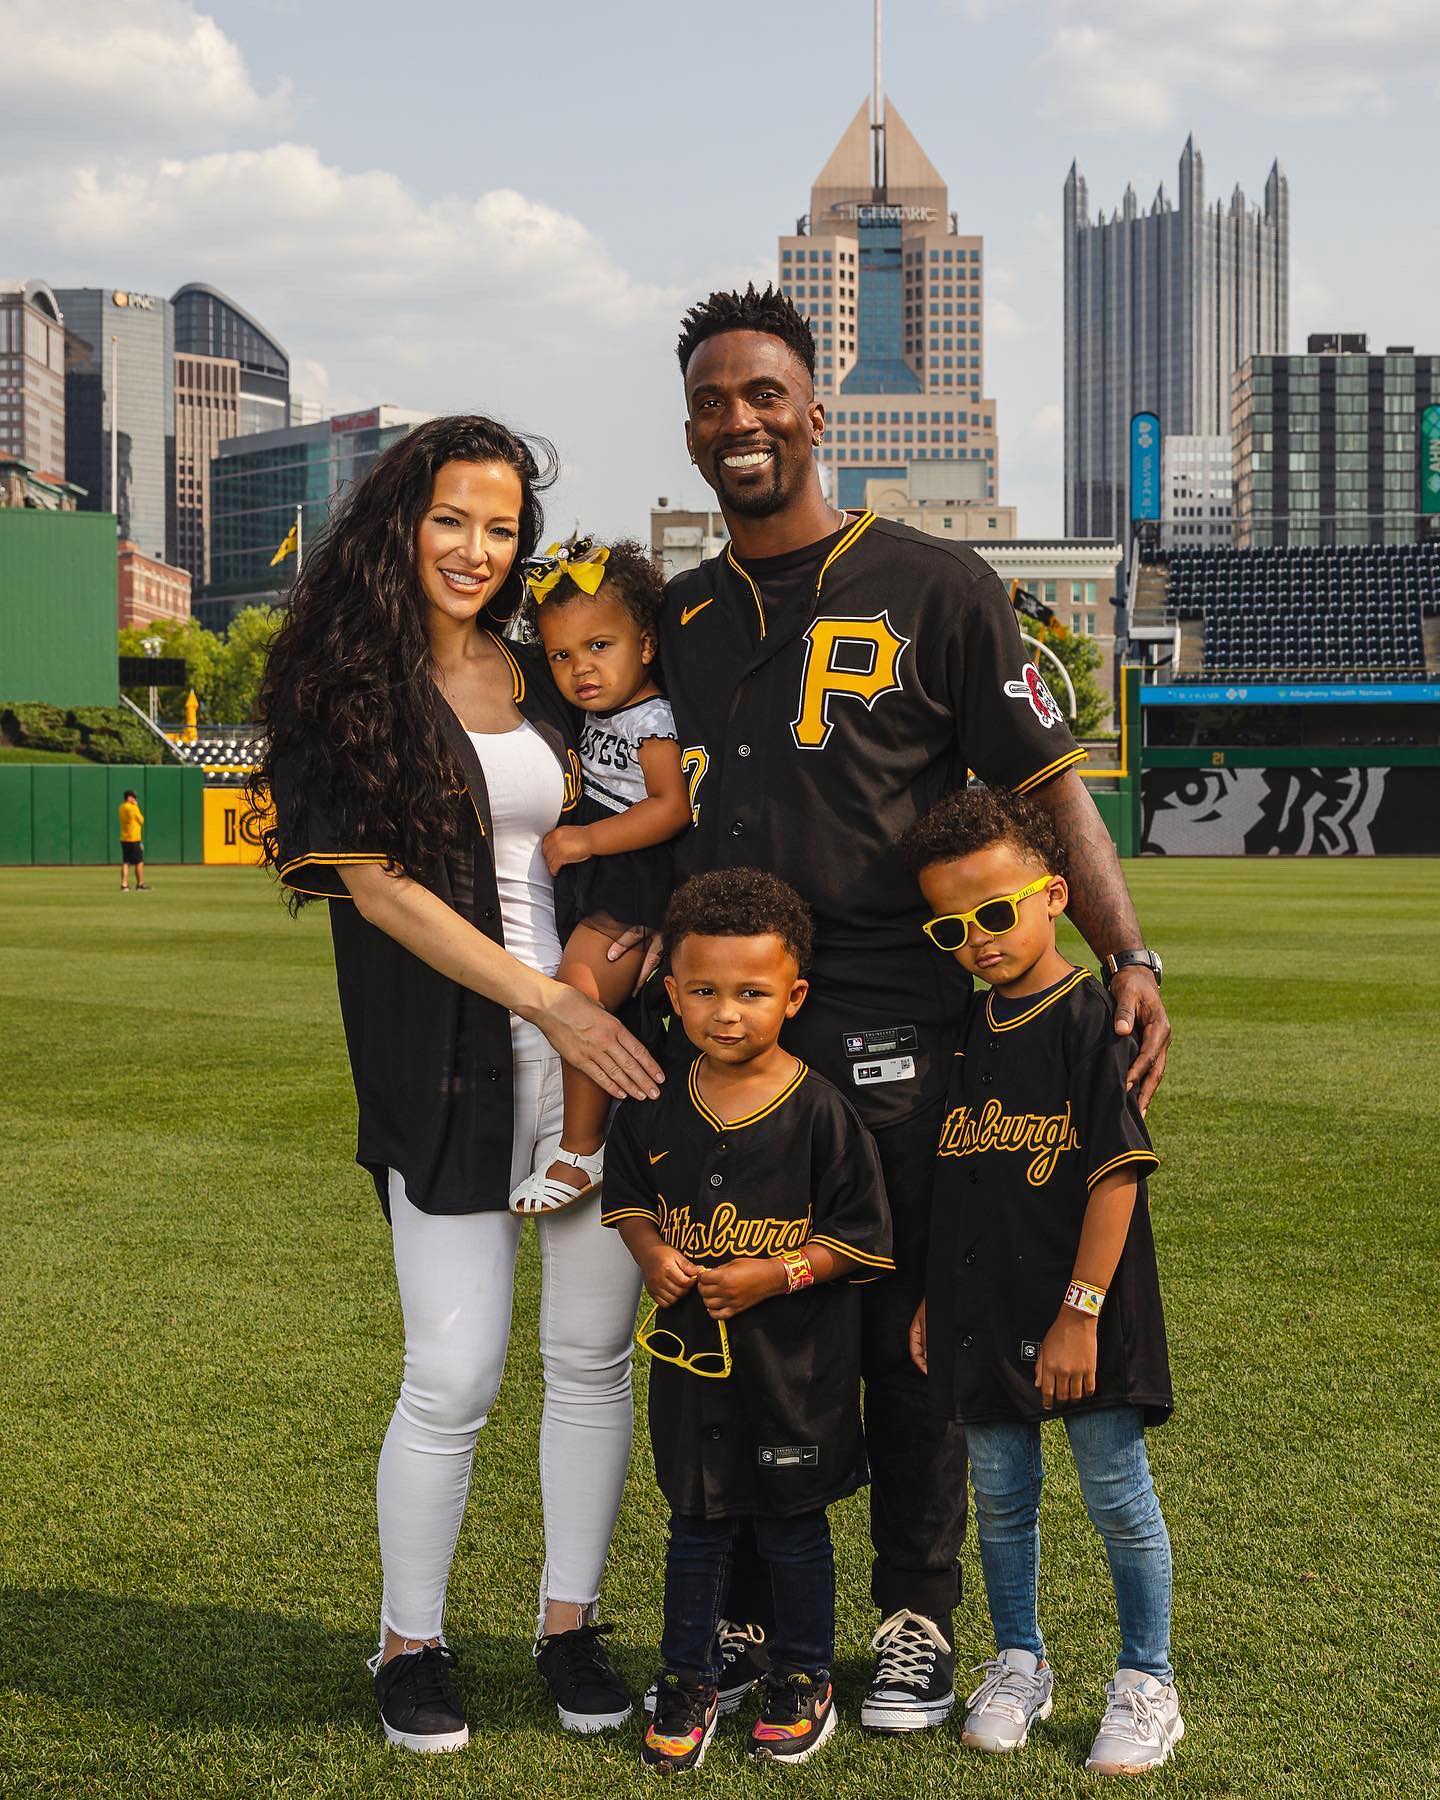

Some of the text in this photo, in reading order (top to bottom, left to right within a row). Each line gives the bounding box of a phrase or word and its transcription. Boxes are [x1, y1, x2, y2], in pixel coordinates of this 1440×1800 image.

[840, 205, 928, 221] HIGHMARK
[129, 293, 155, 310] PNC
[790, 609, 911, 750] P
[1330, 689, 1358, 697] Health
[1359, 689, 1393, 697] Network
[1211, 751, 1225, 766] 21
